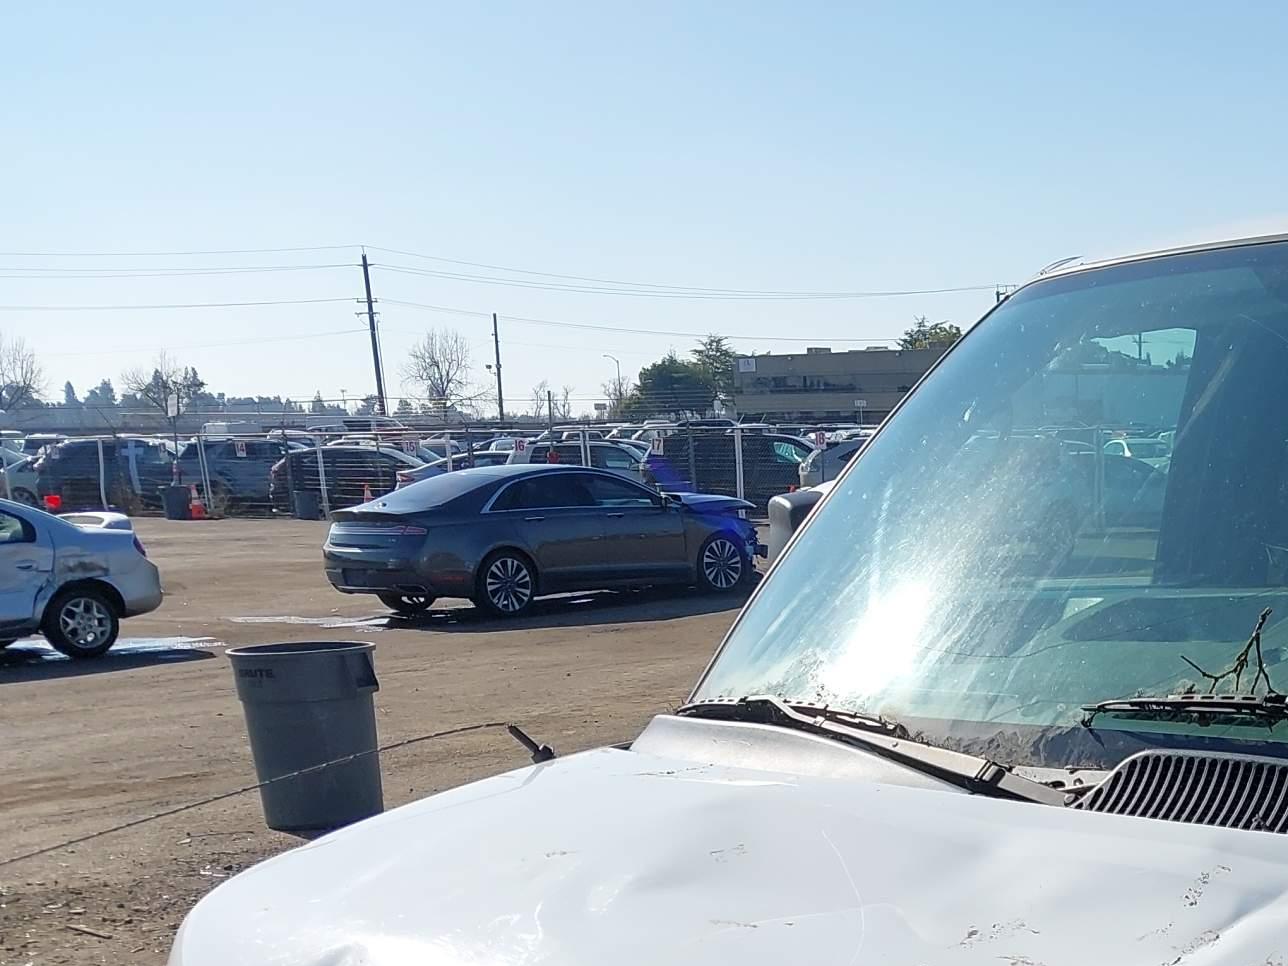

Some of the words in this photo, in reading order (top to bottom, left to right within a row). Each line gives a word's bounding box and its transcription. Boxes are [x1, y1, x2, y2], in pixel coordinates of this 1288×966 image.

[235, 442, 246, 453] 14
[405, 441, 415, 452] 15
[514, 439, 525, 451] 16
[651, 438, 662, 451] 17
